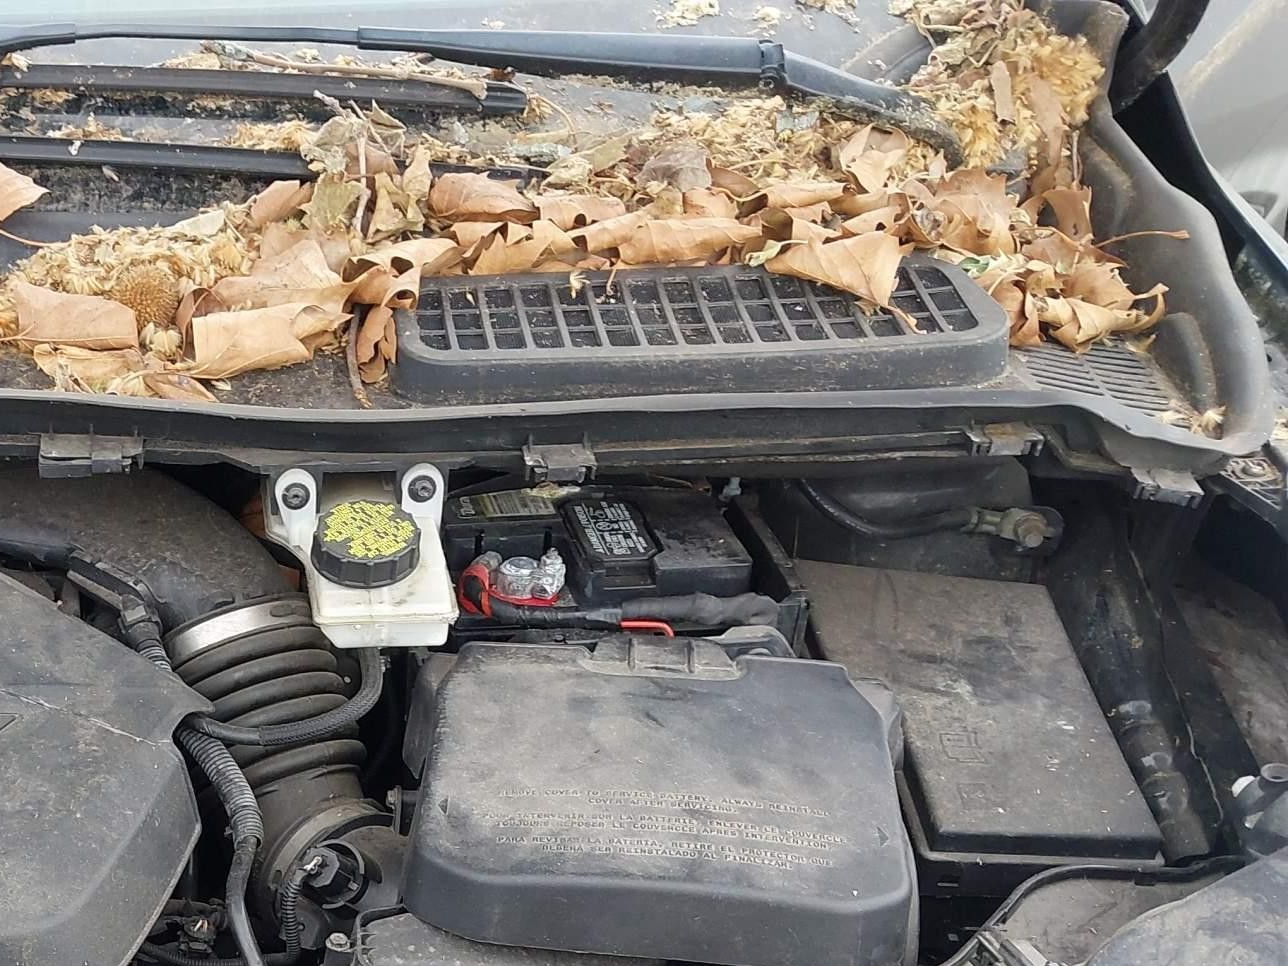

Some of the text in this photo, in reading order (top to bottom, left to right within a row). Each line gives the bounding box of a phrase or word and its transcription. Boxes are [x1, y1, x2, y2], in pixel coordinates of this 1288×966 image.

[588, 797, 623, 806] COVER
[612, 821, 625, 829] LE
[632, 822, 697, 834] COUVERCLE
[496, 836, 527, 844] PARA
[587, 837, 603, 845] LA
[671, 841, 714, 852] RETIRE
[719, 845, 736, 854] EL
[741, 847, 807, 864] PROTECTOR
[811, 856, 834, 868] QUE
[590, 846, 613, 854] SER
[618, 847, 697, 859] REINSTALADO
[703, 852, 718, 861] AL
